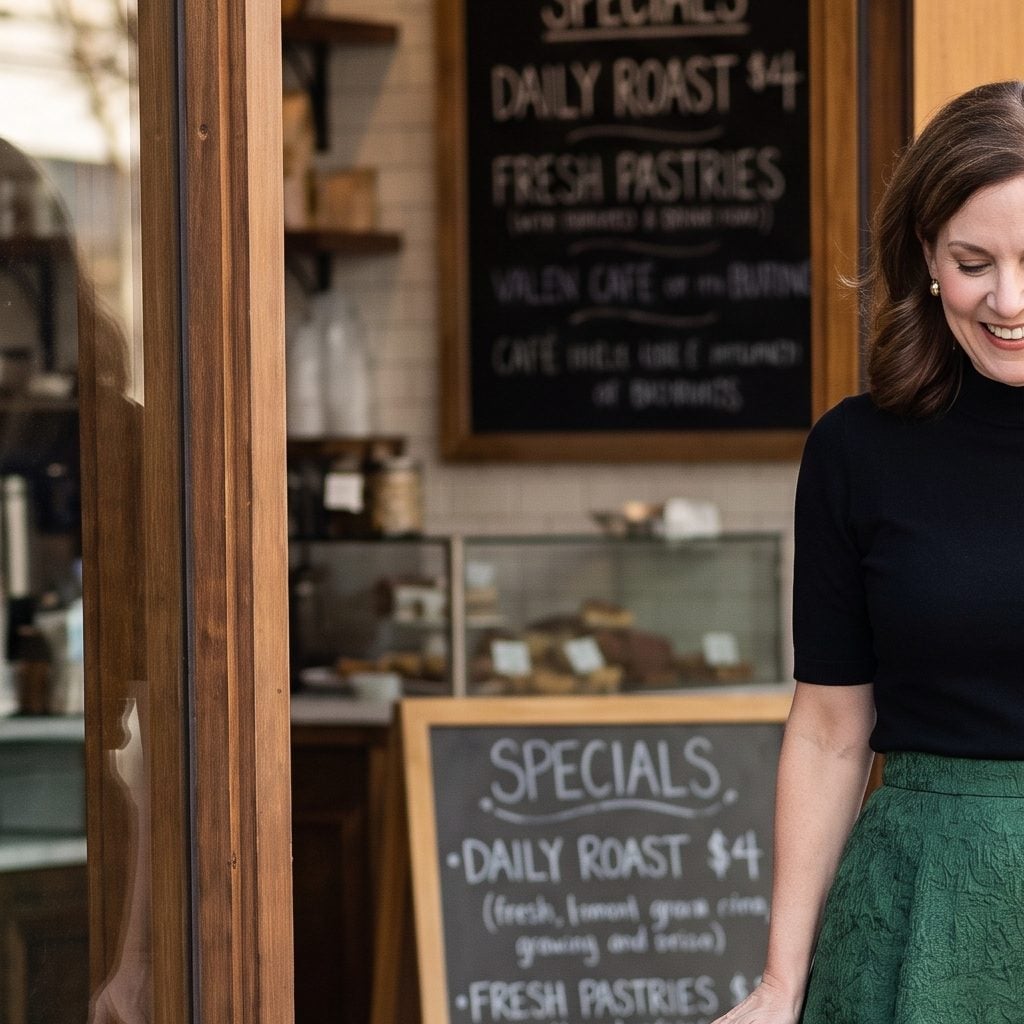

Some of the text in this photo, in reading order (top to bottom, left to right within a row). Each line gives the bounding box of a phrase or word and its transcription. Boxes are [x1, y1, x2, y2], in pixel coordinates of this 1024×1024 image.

[491, 50, 803, 121] DAILY ROAST $4
[491, 146, 785, 206] FRESH PASTRIES
[490, 737, 721, 803] SPECIALS
[462, 828, 762, 885] DAILY ROAST $4
[469, 980, 568, 1023] FRESH
[578, 975, 719, 1017] PASTRIES
